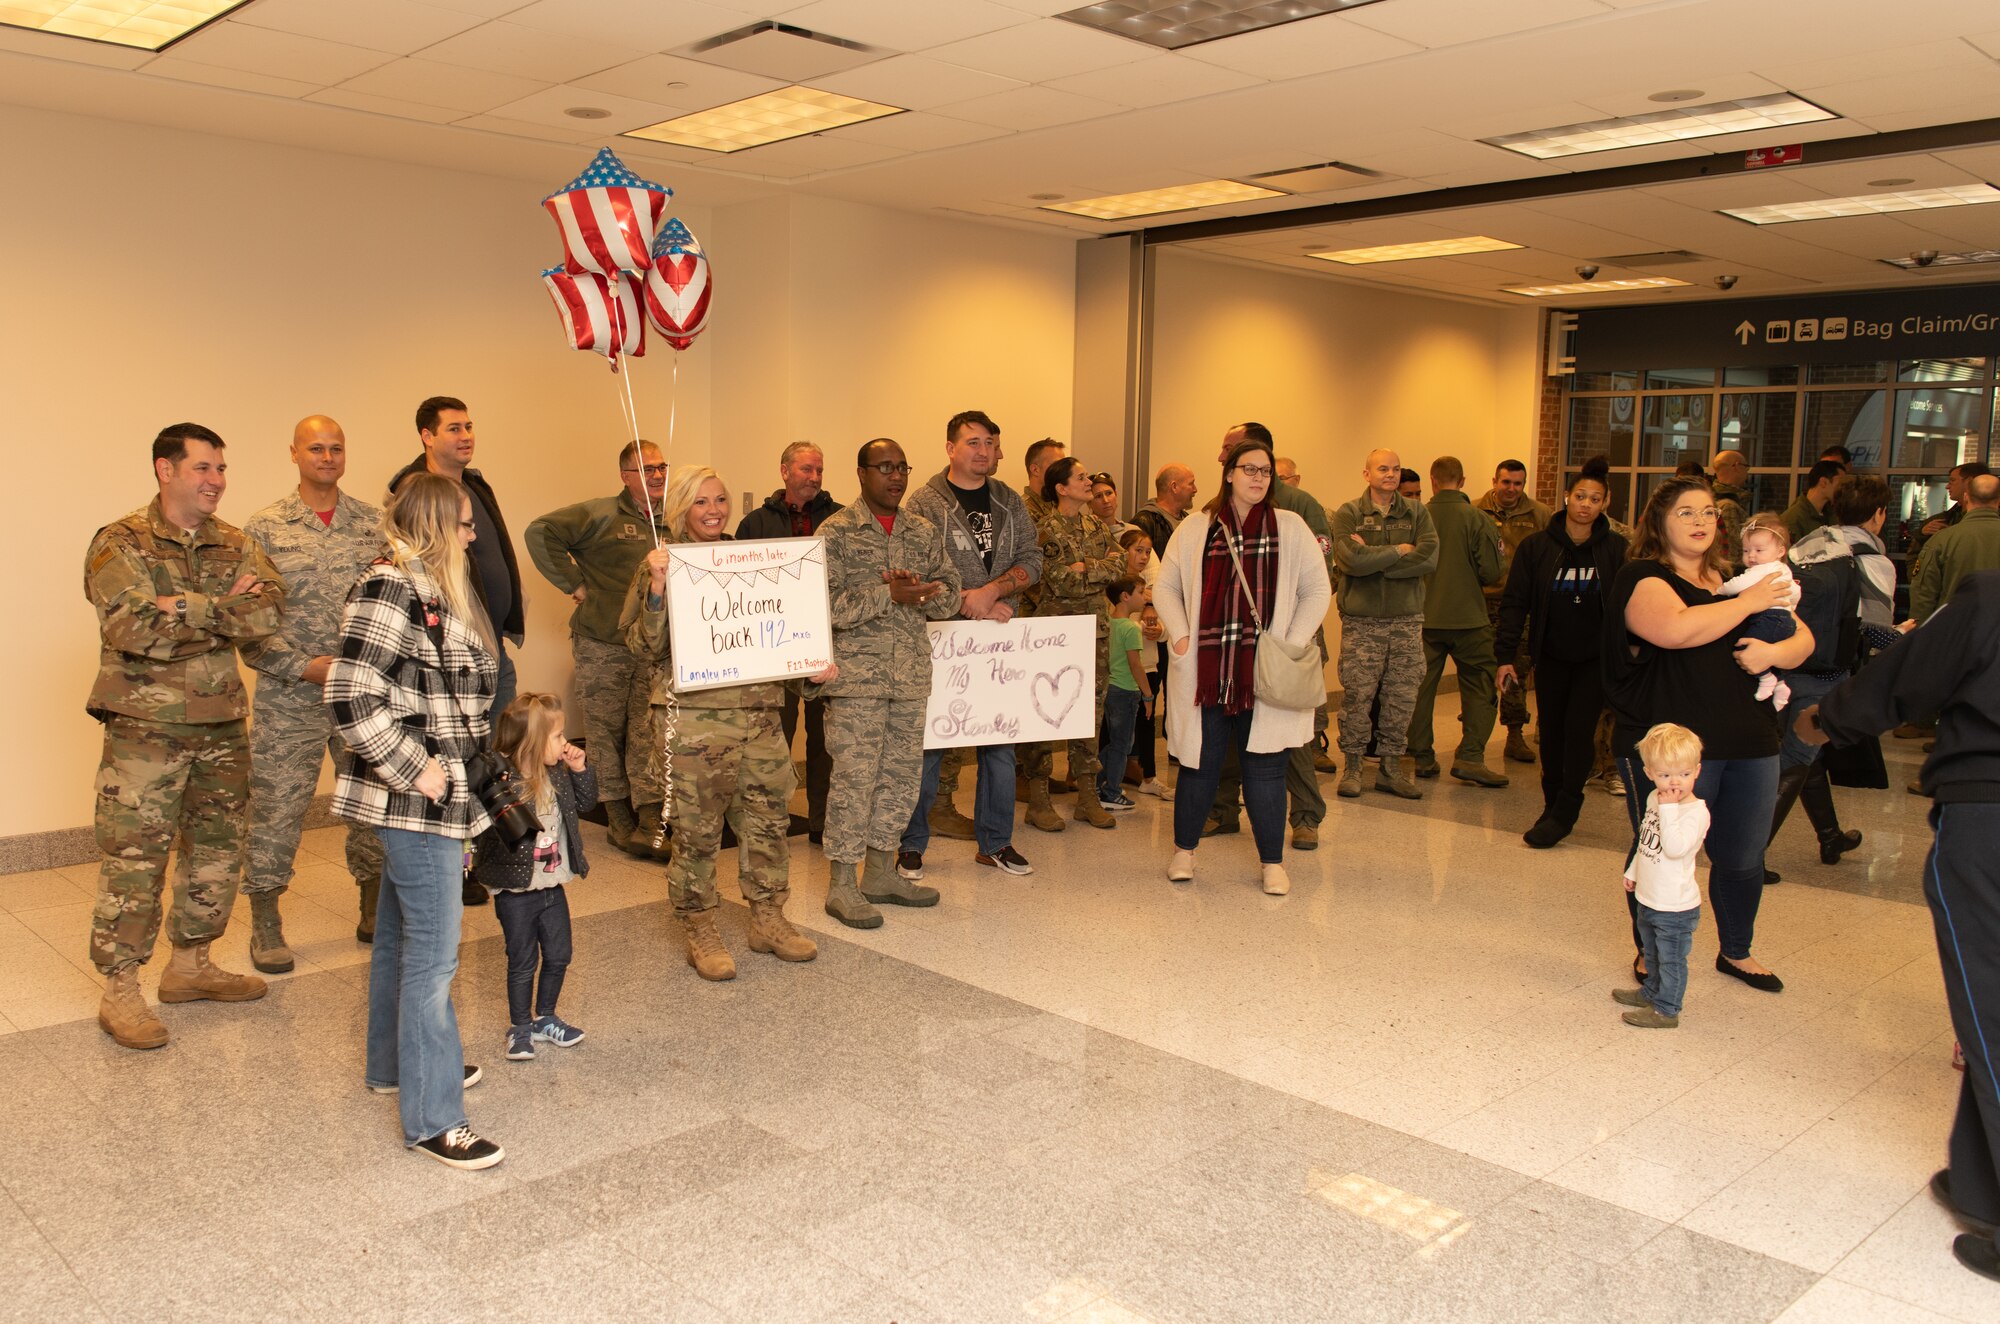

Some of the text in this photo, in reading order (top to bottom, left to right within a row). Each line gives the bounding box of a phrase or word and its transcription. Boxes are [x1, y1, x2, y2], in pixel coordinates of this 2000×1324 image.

[1853, 314, 2000, 340] Bag Claim/Gr
[712, 548, 723, 566] 6
[726, 551, 764, 565] months
[701, 591, 784, 621] Welcome
[711, 619, 811, 654] back 192 MXG
[930, 630, 1015, 660] Welcome
[680, 665, 739, 684] Langley AFB
[787, 658, 829, 672] F22 Raptors
[946, 658, 1026, 695] My Hero
[931, 698, 1020, 739] Stanley
